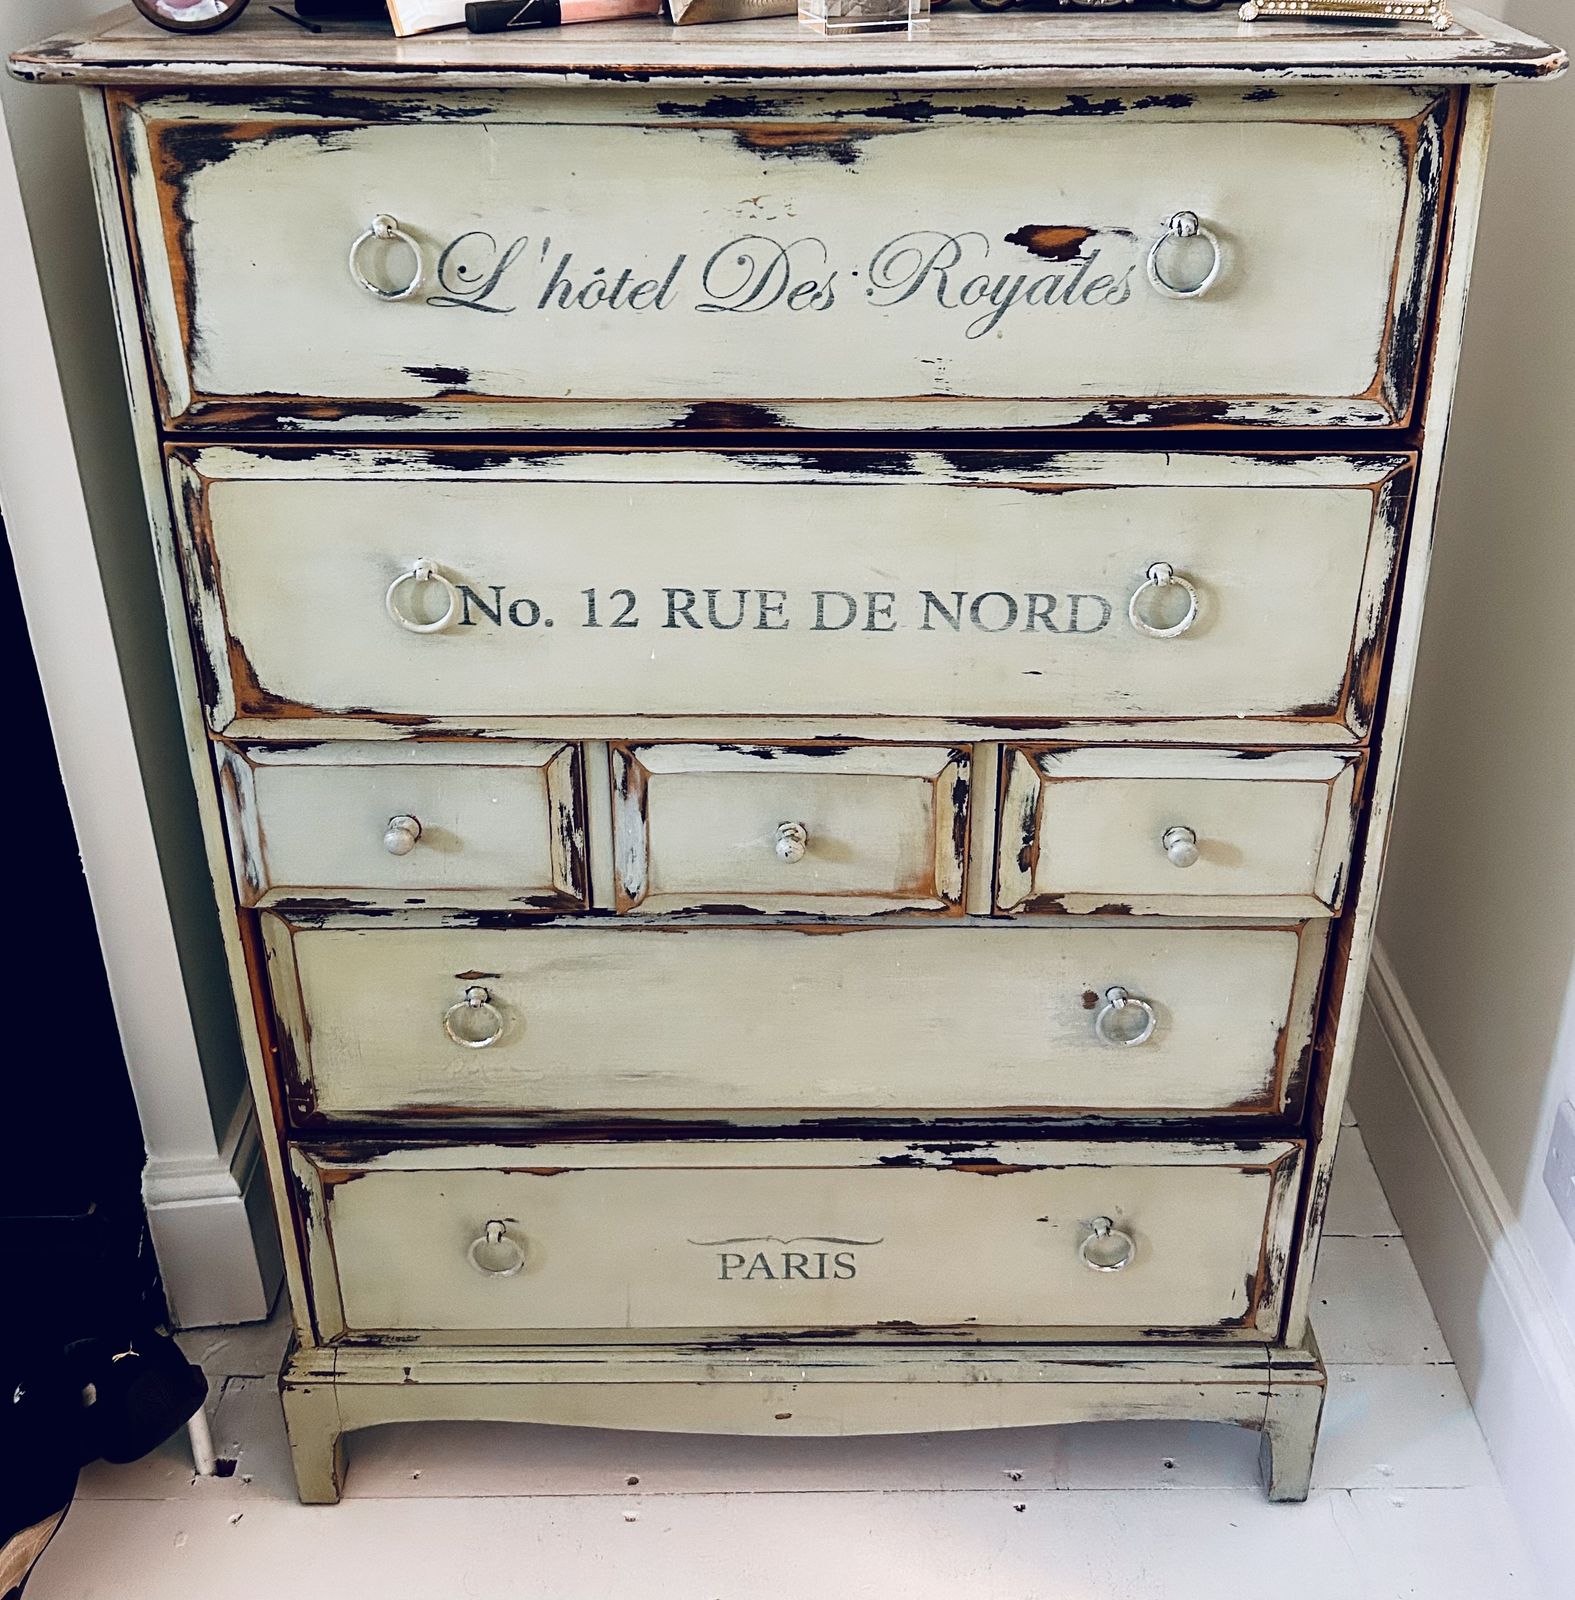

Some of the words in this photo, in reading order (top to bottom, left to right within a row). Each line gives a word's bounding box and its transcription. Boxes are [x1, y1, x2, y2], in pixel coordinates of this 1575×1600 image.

[694, 233, 838, 313] Des
[867, 230, 1136, 340] Royales
[455, 585, 554, 628] No.
[581, 587, 640, 628] 12
[661, 587, 790, 630] RUE
[809, 589, 897, 632] DE
[917, 590, 1113, 634] NORD
[716, 1251, 857, 1280] PARIS
